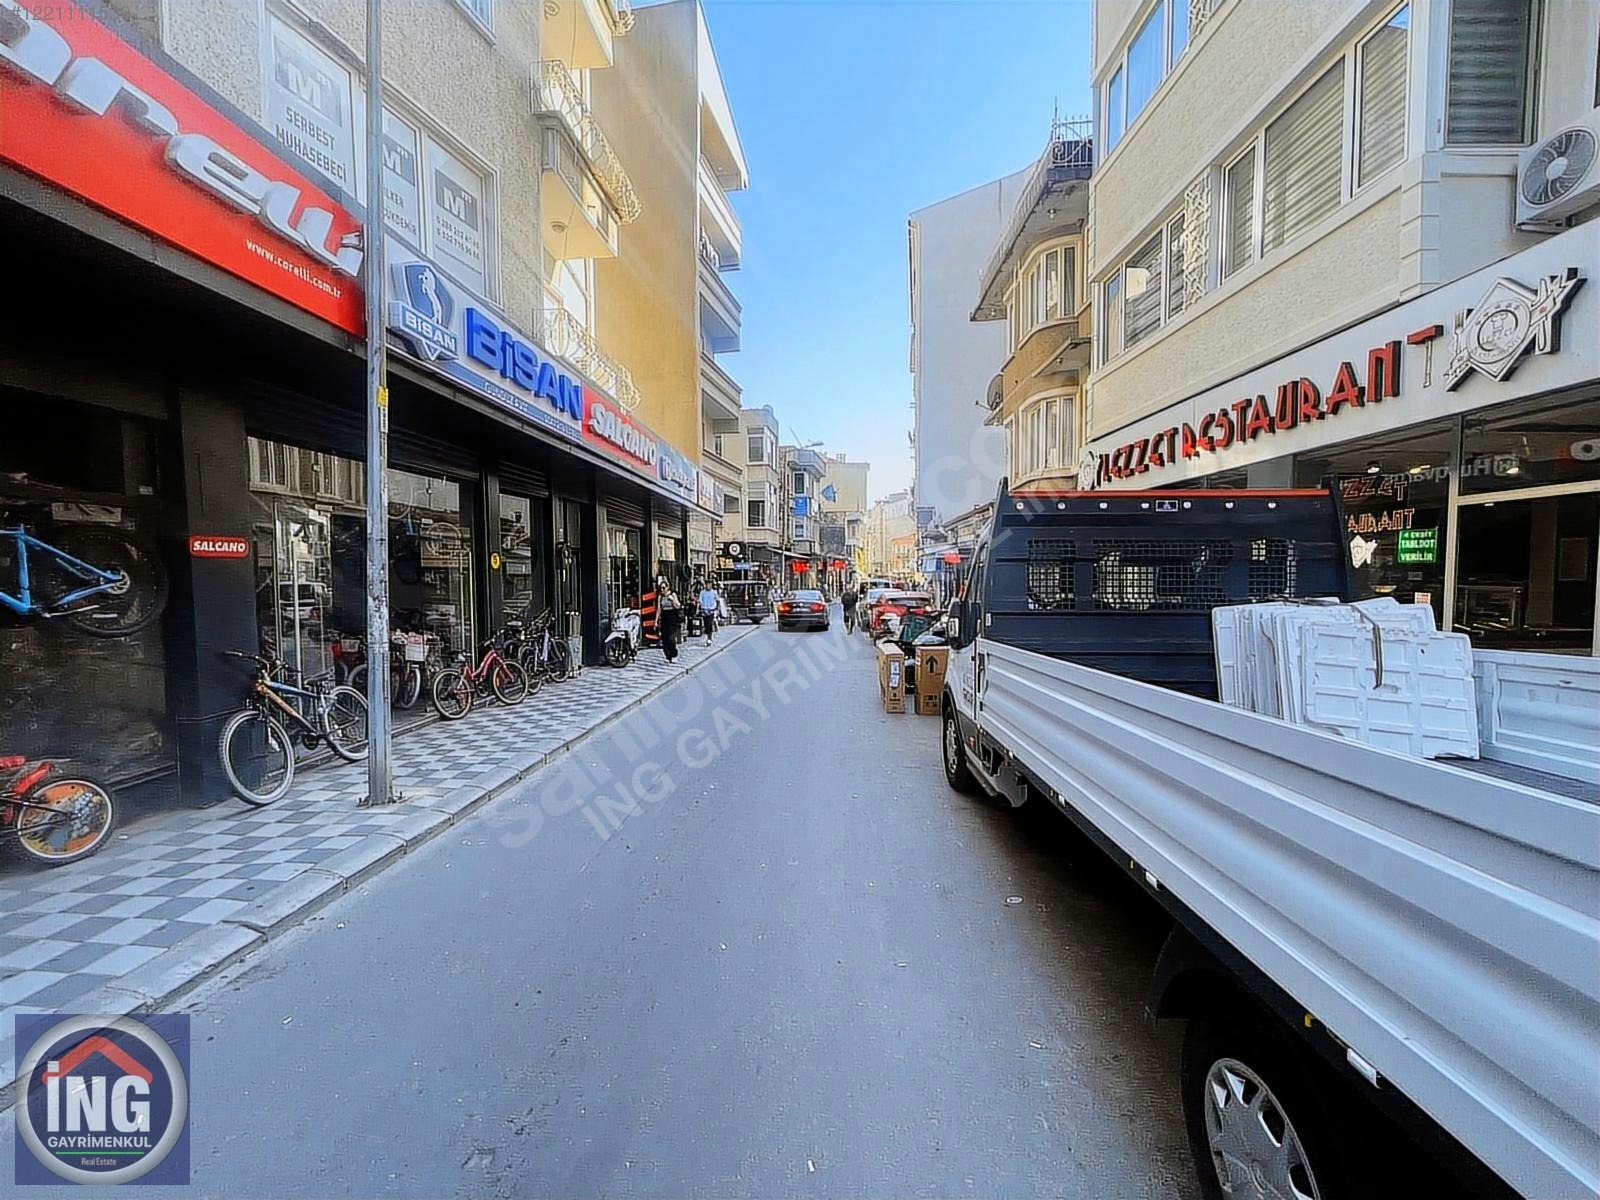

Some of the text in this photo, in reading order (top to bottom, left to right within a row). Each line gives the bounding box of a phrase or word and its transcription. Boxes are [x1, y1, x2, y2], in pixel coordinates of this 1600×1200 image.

[285, 106, 336, 151] SERBEST
[246, 238, 341, 298] www.corelli.com.tr
[1181, 324, 1444, 461] RESTAURANT
[589, 403, 657, 466] SALCANO
[193, 540, 246, 552] SALCANO
